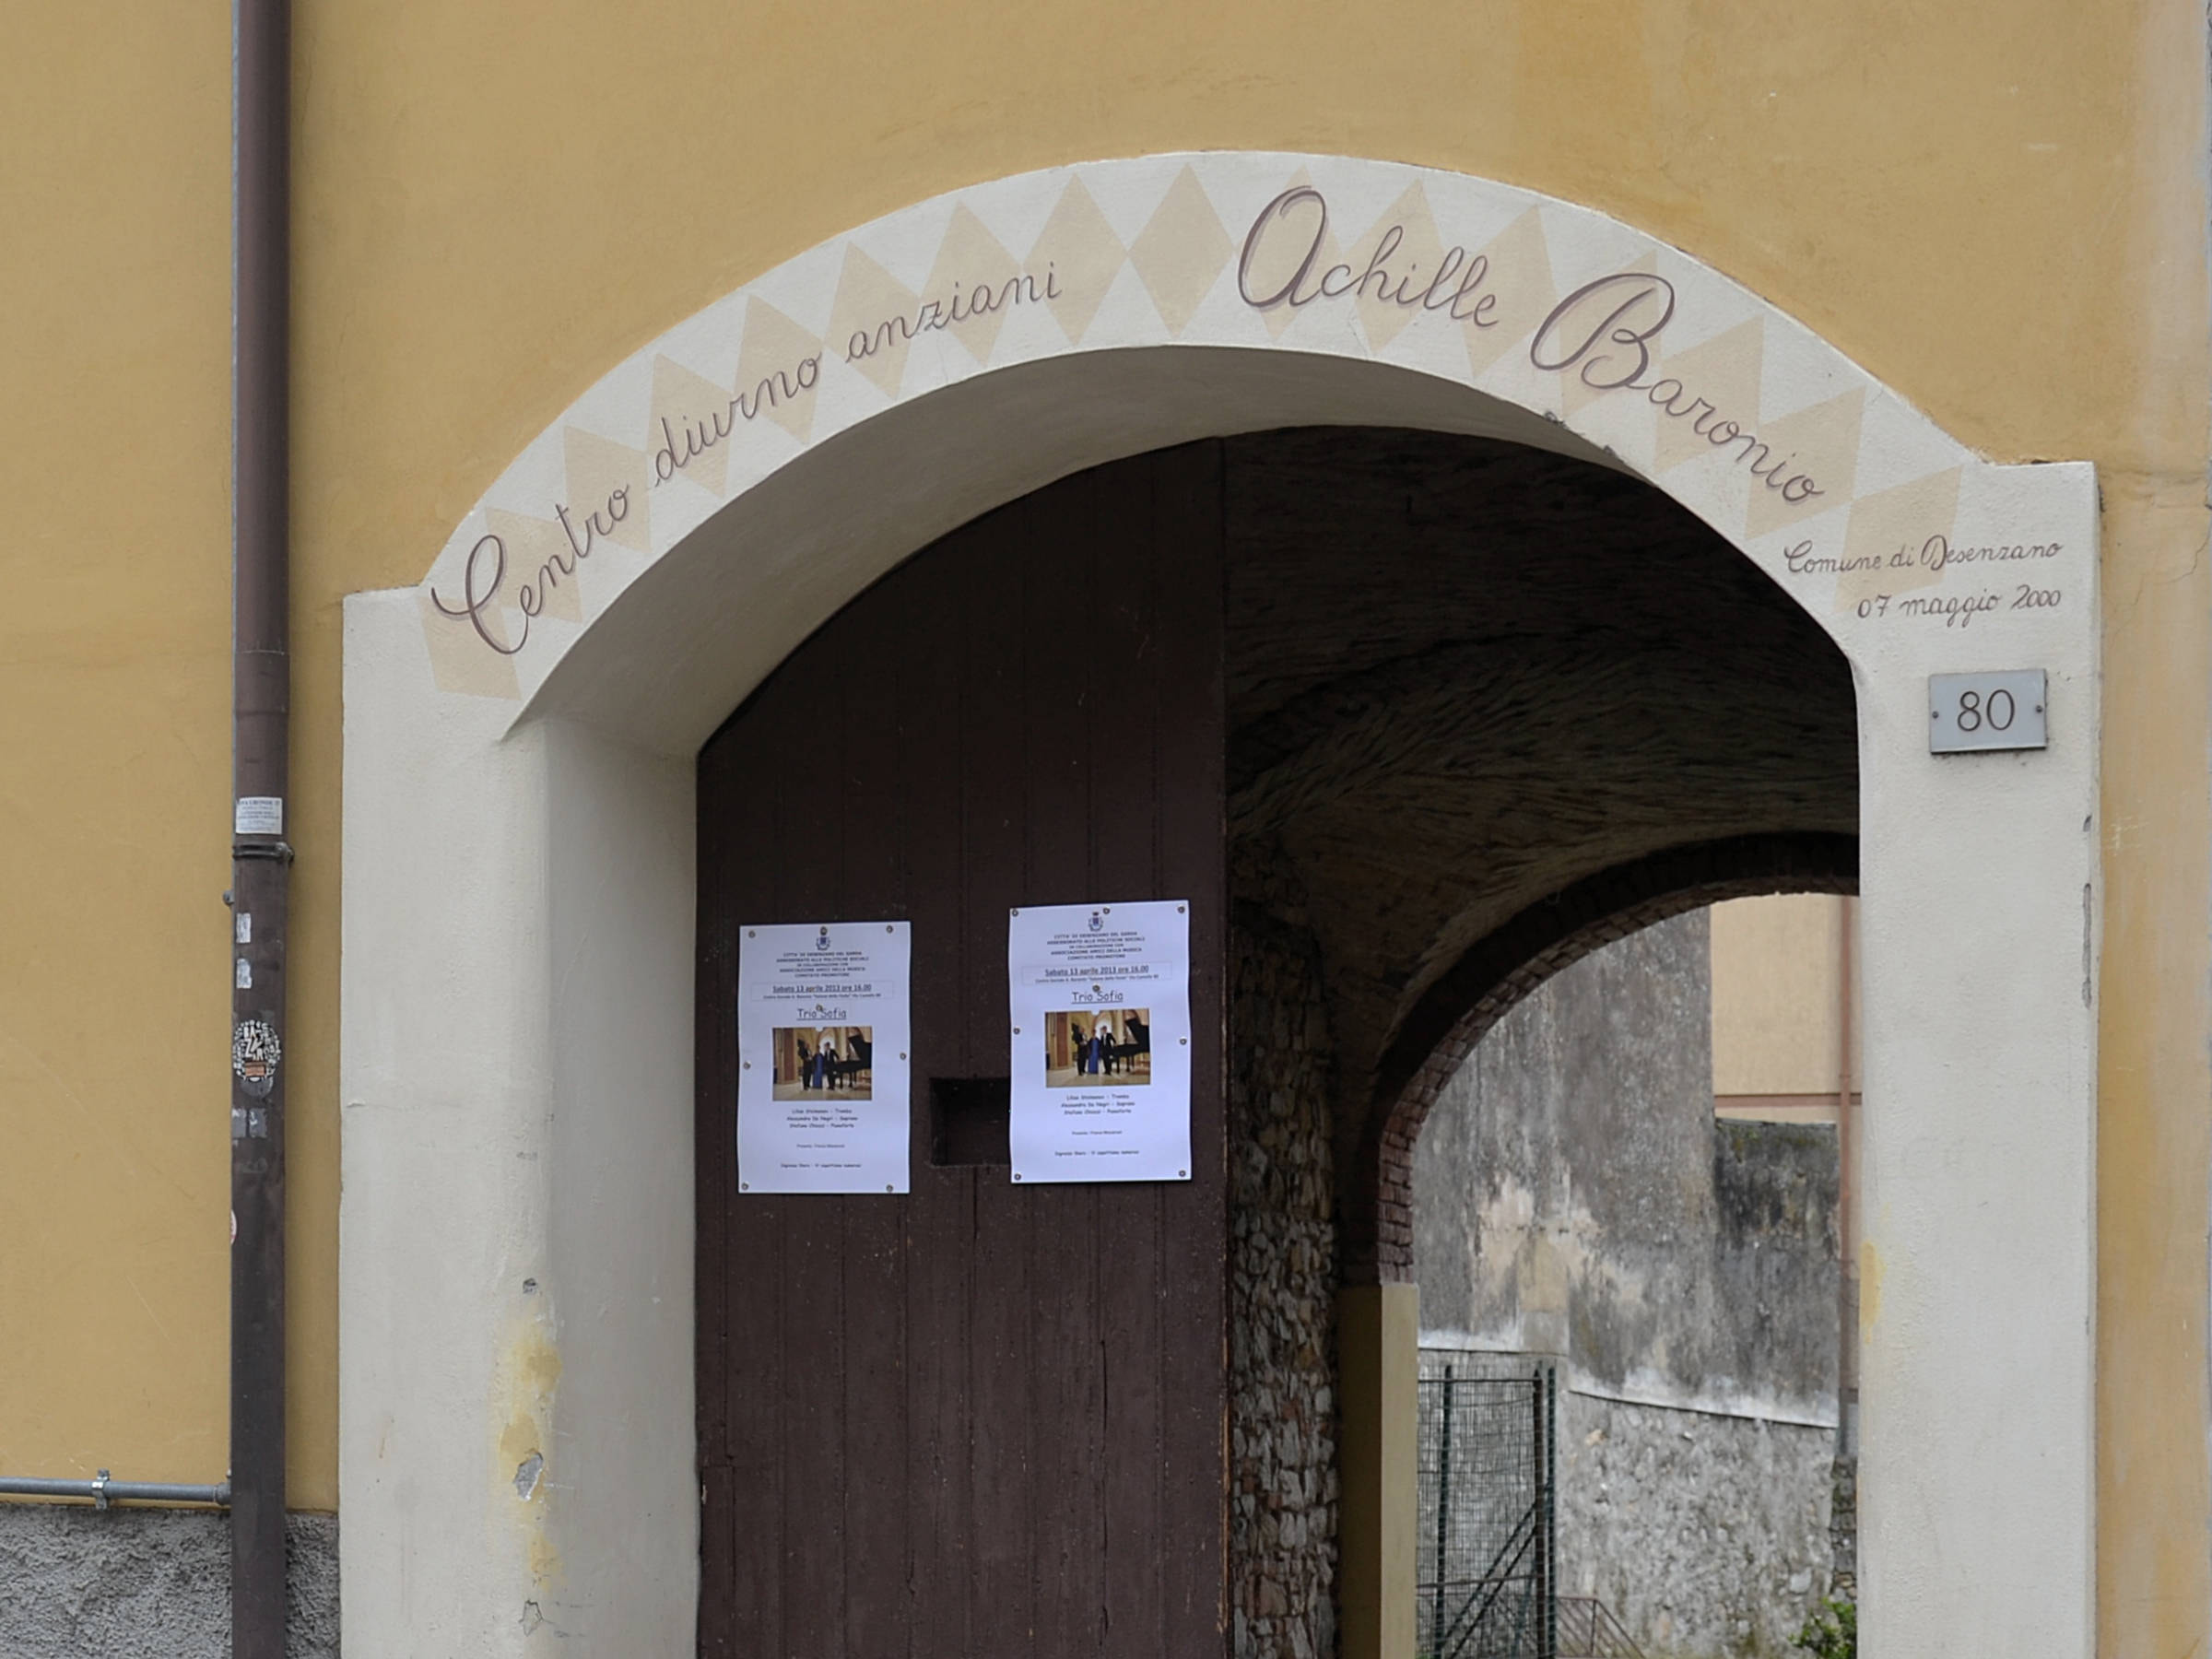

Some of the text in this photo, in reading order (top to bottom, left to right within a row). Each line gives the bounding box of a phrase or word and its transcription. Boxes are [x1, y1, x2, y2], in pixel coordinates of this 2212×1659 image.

[430, 184, 1826, 656] Centro diurno anziani Achille Baronio
[1783, 534, 2064, 573] Comune di Desenzano
[1857, 583, 2063, 629] 07 maggio 2000
[1957, 688, 2016, 732] 80
[1045, 968, 1069, 977] Sabato
[1070, 968, 1078, 976] 13
[1079, 968, 1099, 976] aprile
[1100, 967, 1117, 975] 2013
[1131, 965, 1150, 973] 16.00
[772, 984, 795, 994] Sabato
[796, 984, 805, 993] 13
[825, 983, 841, 993] 2013
[1072, 990, 1124, 1004] Trio Sofia
[797, 1006, 847, 1019] Trio Sofia
